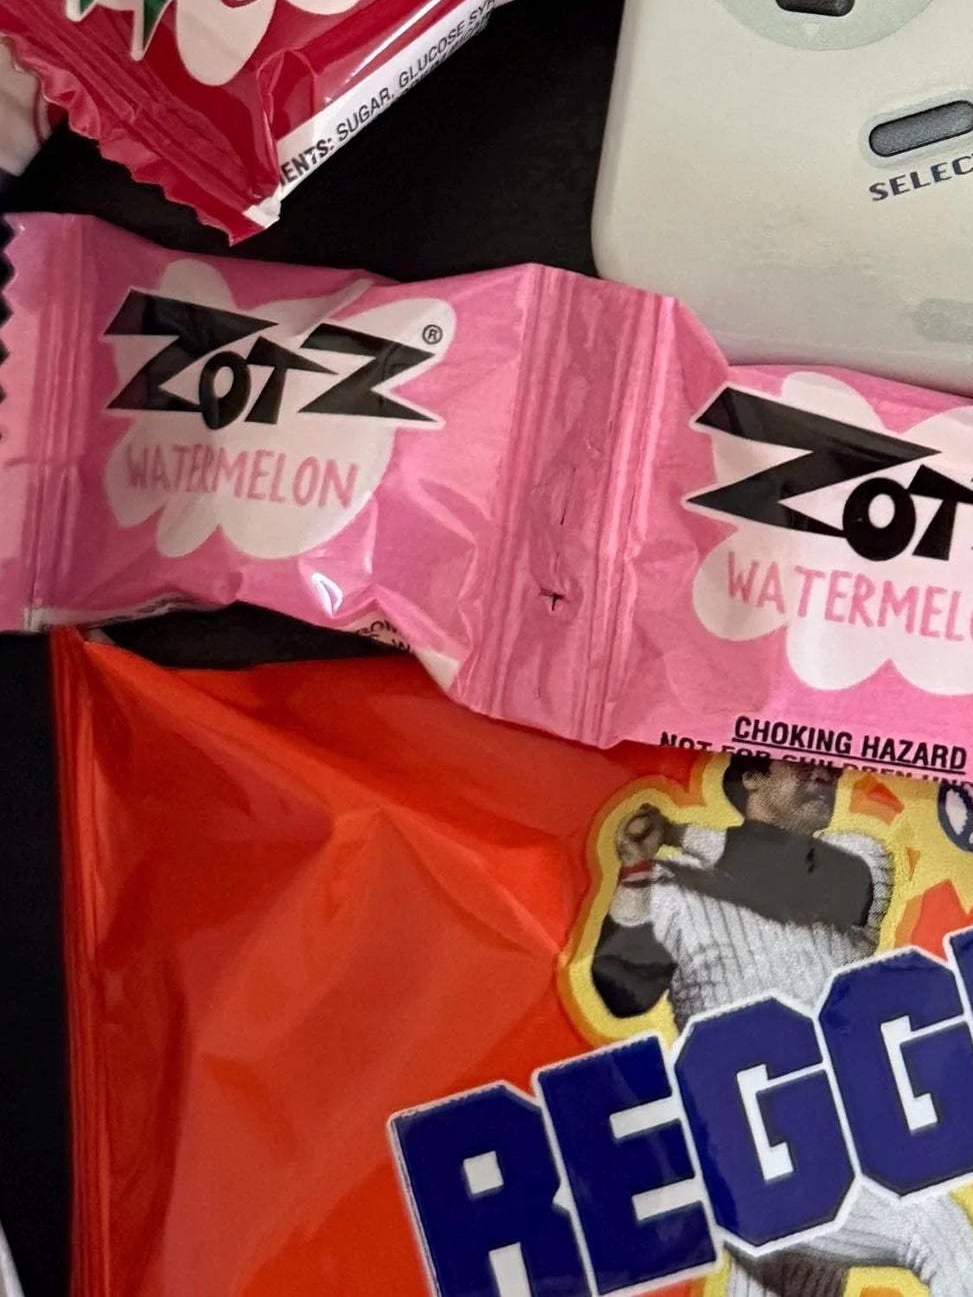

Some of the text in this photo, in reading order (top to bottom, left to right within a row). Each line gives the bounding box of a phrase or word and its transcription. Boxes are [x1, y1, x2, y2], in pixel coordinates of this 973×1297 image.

[398, 19, 466, 89] GLUCOSE
[103, 288, 438, 430] ZOTZ
[126, 442, 359, 509] WATERMELON
[733, 715, 968, 772] CHOKING HAZARD
